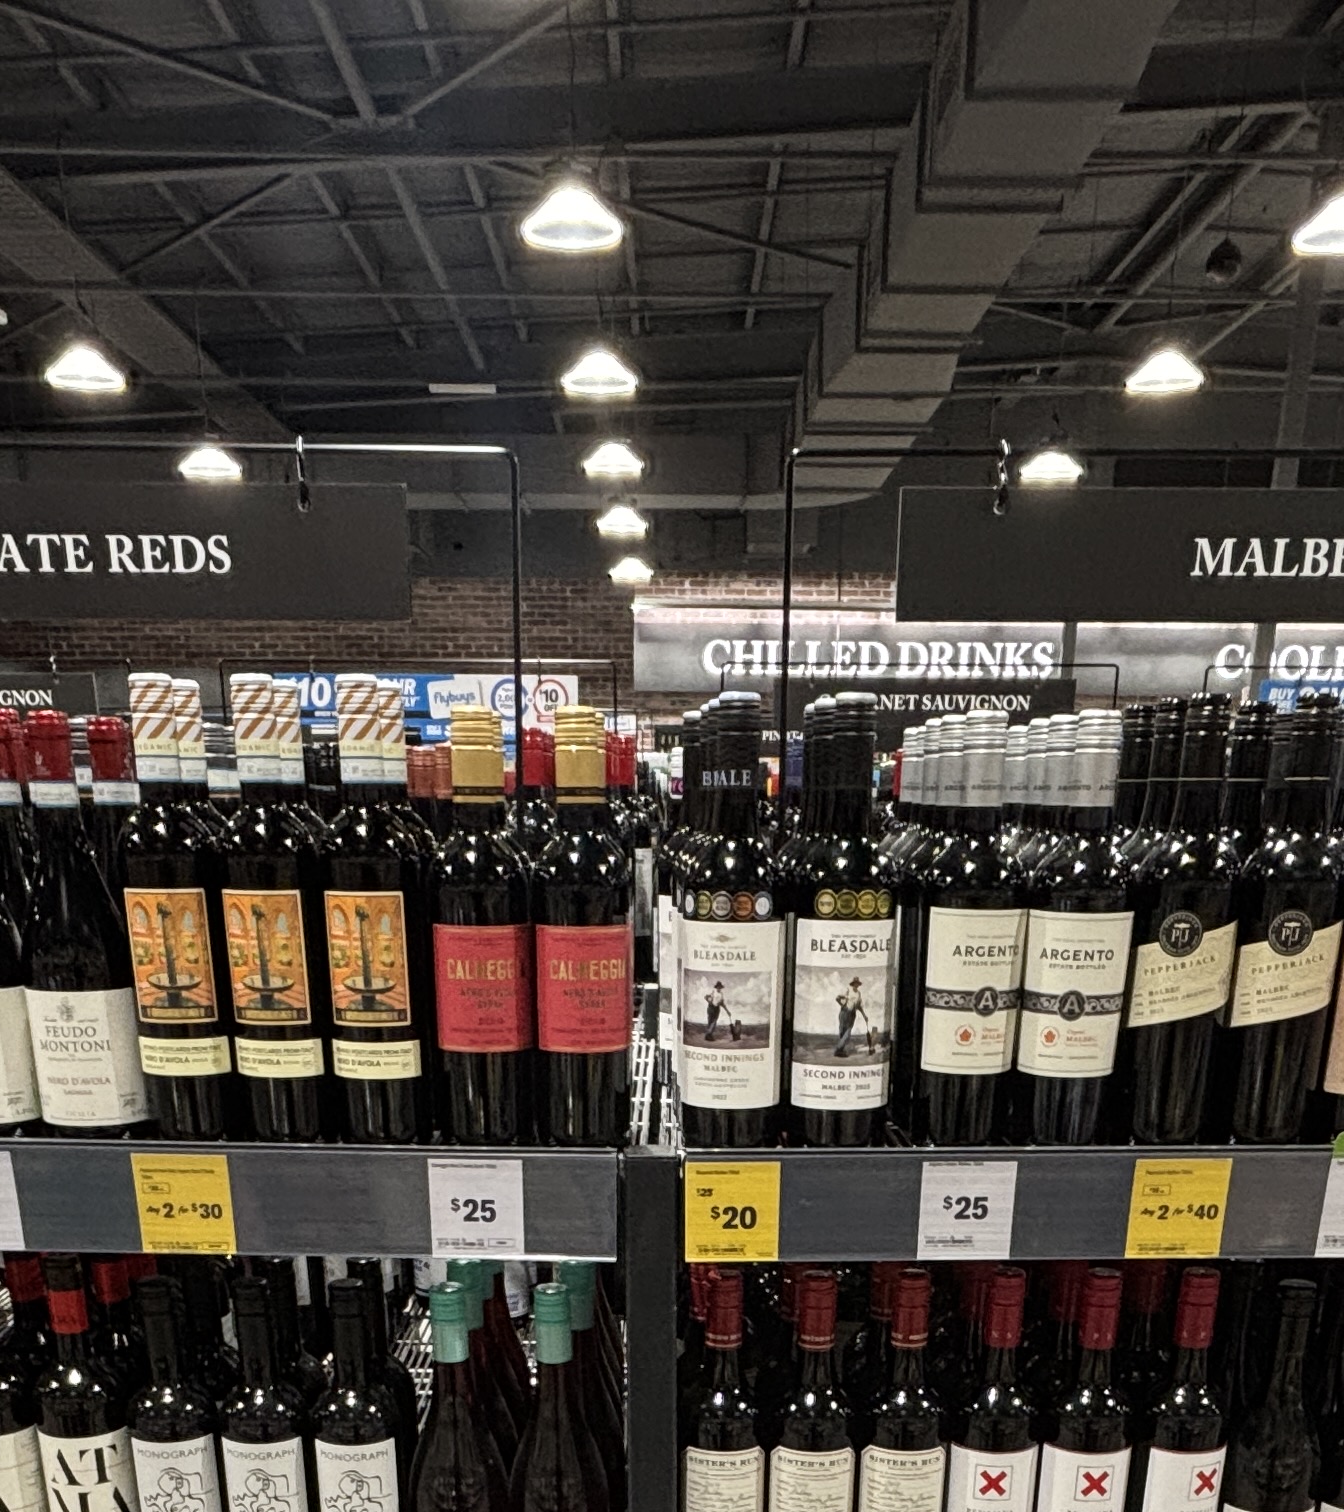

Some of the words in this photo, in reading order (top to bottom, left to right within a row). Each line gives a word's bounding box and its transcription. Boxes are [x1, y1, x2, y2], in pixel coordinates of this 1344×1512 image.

[107, 533, 233, 575] REDS
[702, 640, 891, 680] CHILLED
[896, 640, 1055, 680] DRINKS
[432, 689, 476, 706] flybuys
[920, 692, 1032, 712] SAUVIGNON
[810, 937, 892, 954] BLEASDALE
[692, 948, 757, 962] BLEASDALE
[1039, 947, 1115, 962] ARGENTO
[1250, 953, 1326, 976] PEPPERJACK
[44, 1024, 98, 1040] FEUDO
[38, 1038, 113, 1054] MONTONI
[162, 1202, 176, 1219] 2
[191, 1202, 223, 1220] $30
[450, 1197, 497, 1223] $25
[943, 1194, 989, 1220] $25
[710, 1205, 757, 1230] $20
[225, 1447, 296, 1461] MONOGRAPH
[320, 1447, 389, 1462] MONOGRAPH
[868, 1454, 920, 1468] SISTER'S
